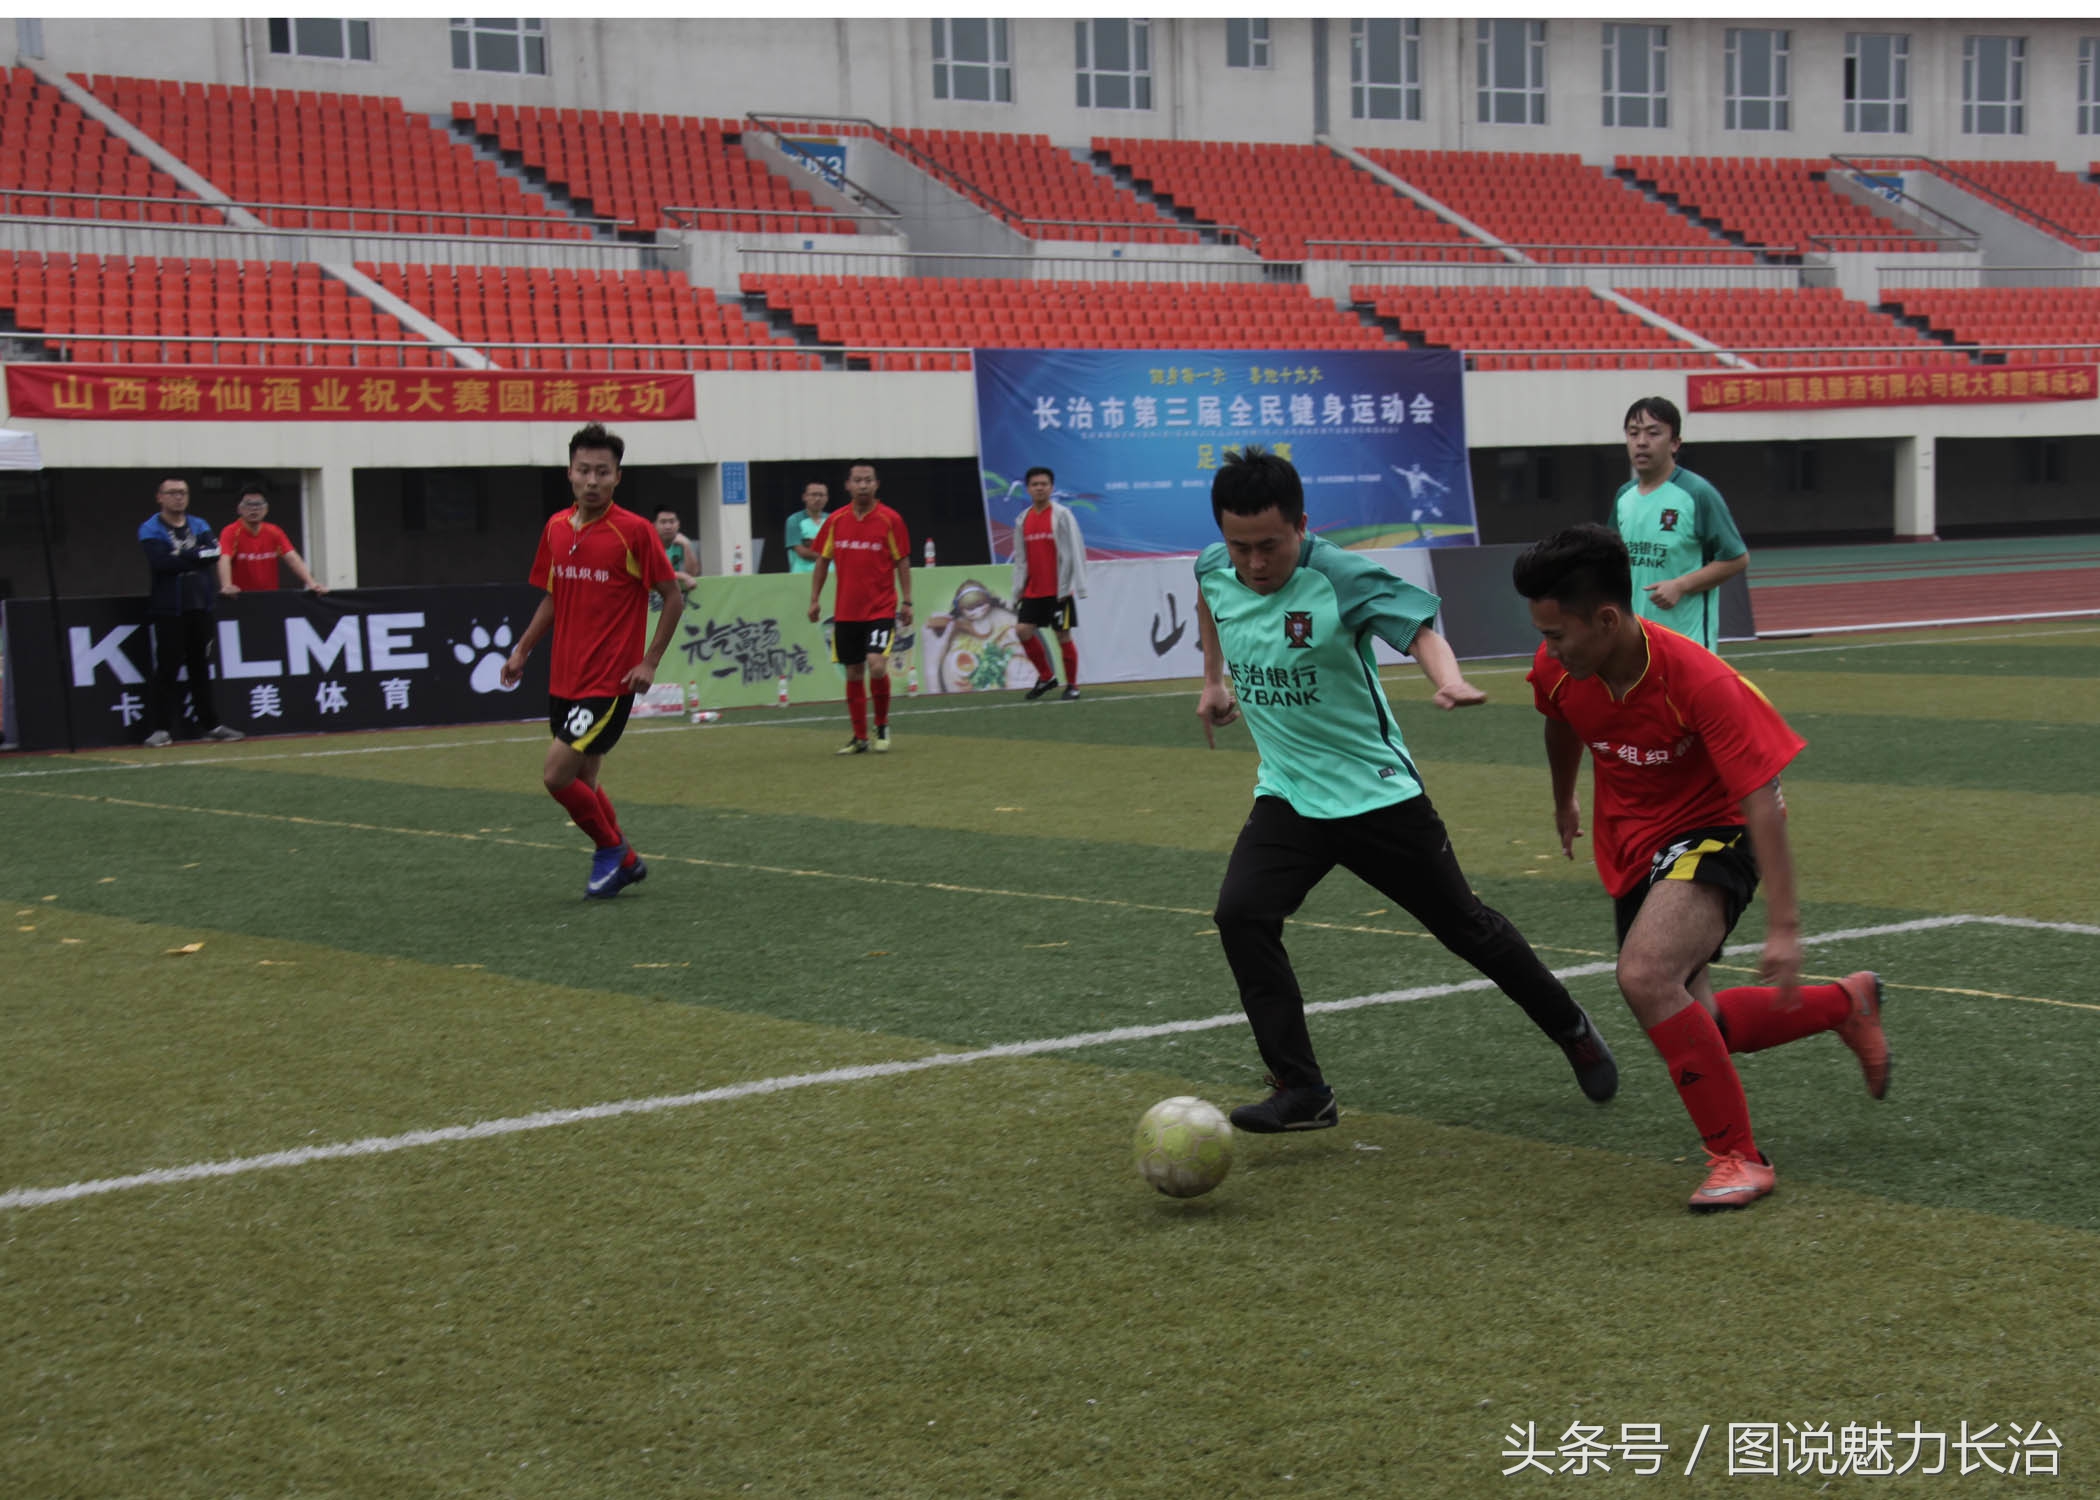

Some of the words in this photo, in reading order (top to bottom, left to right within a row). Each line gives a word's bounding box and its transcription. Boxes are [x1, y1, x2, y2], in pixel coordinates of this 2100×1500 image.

[52, 374, 667, 414] 山西潞仙酒业祝大赛圆满成功
[1033, 393, 1435, 430] 长治市第三届全民健身运动会
[69, 612, 430, 688] KLME
[680, 617, 780, 665] 元气高汤
[869, 628, 889, 648] 11
[110, 679, 411, 727] 卡美体育
